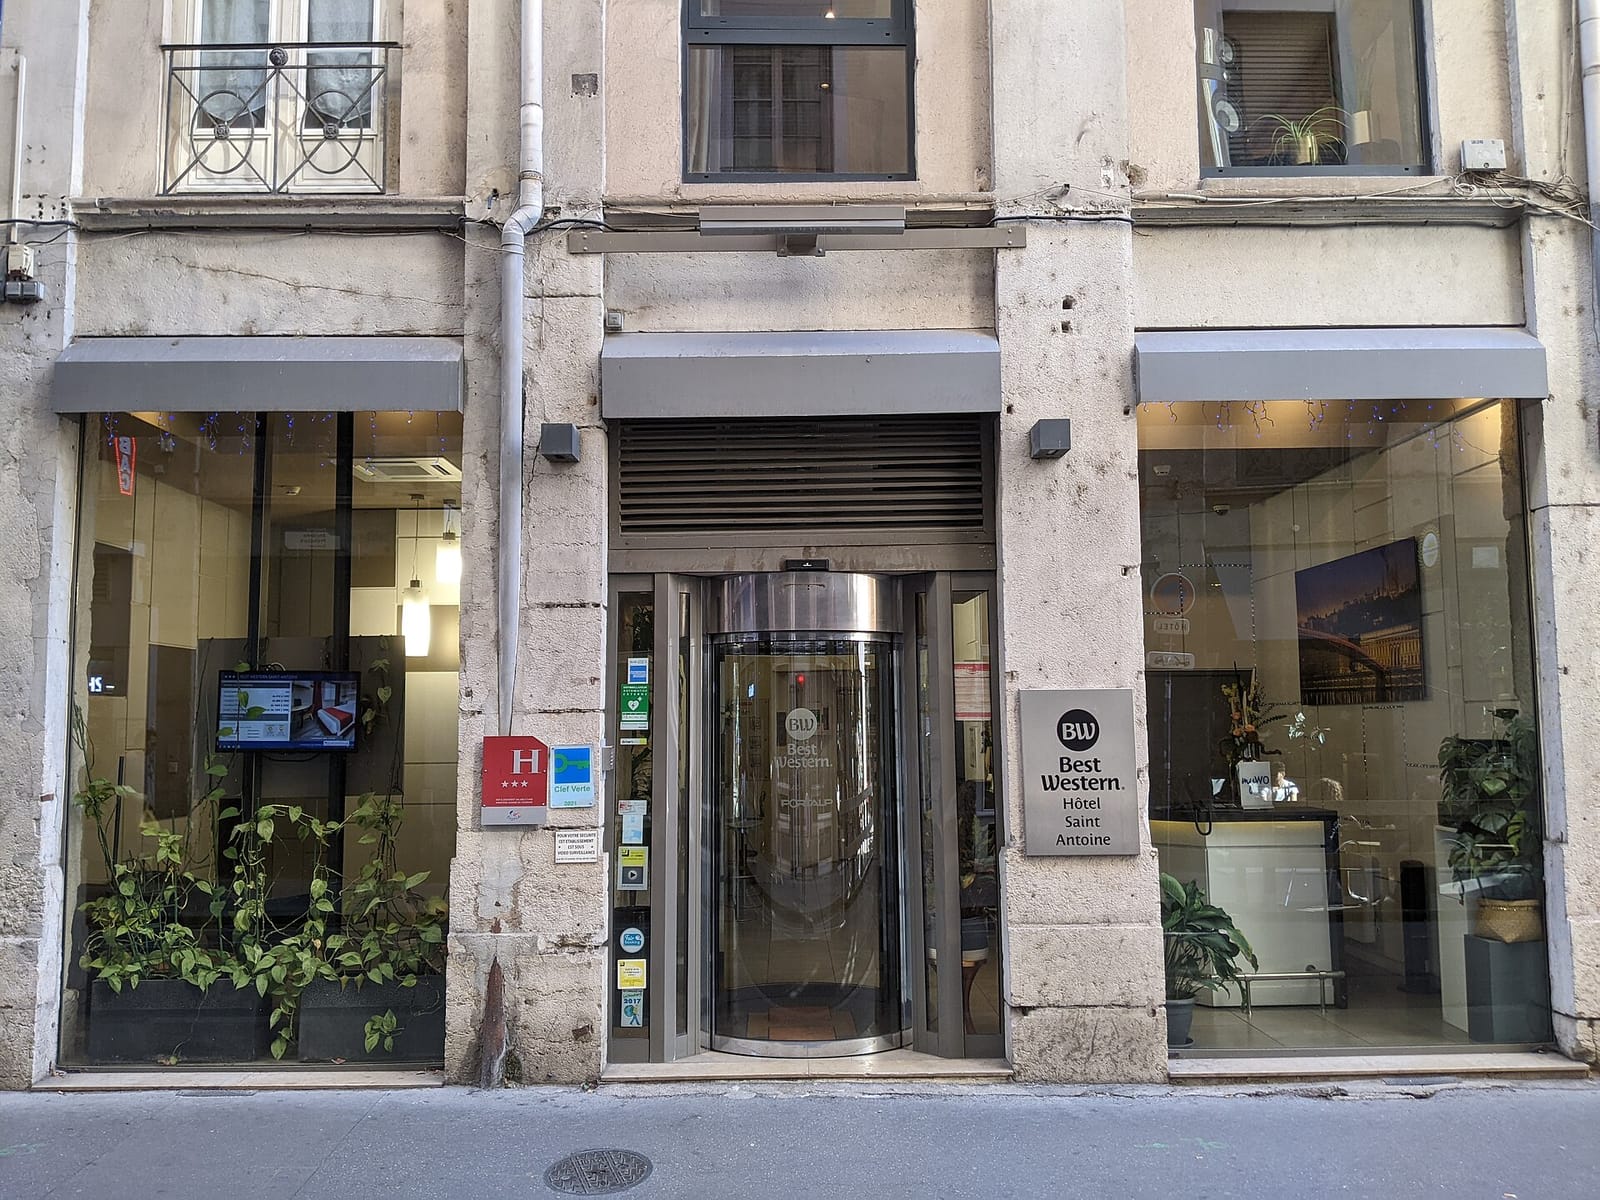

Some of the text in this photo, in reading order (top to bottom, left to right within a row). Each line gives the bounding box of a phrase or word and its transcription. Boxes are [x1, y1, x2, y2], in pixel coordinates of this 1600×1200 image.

[1061, 722, 1096, 741] BW
[787, 743, 818, 756] Best
[511, 749, 542, 775] H
[1059, 756, 1102, 773] Best
[554, 785, 570, 793] Clef
[1063, 797, 1101, 810] Hôtel
[1065, 815, 1100, 828] Saint
[1055, 834, 1111, 846] Antoine
